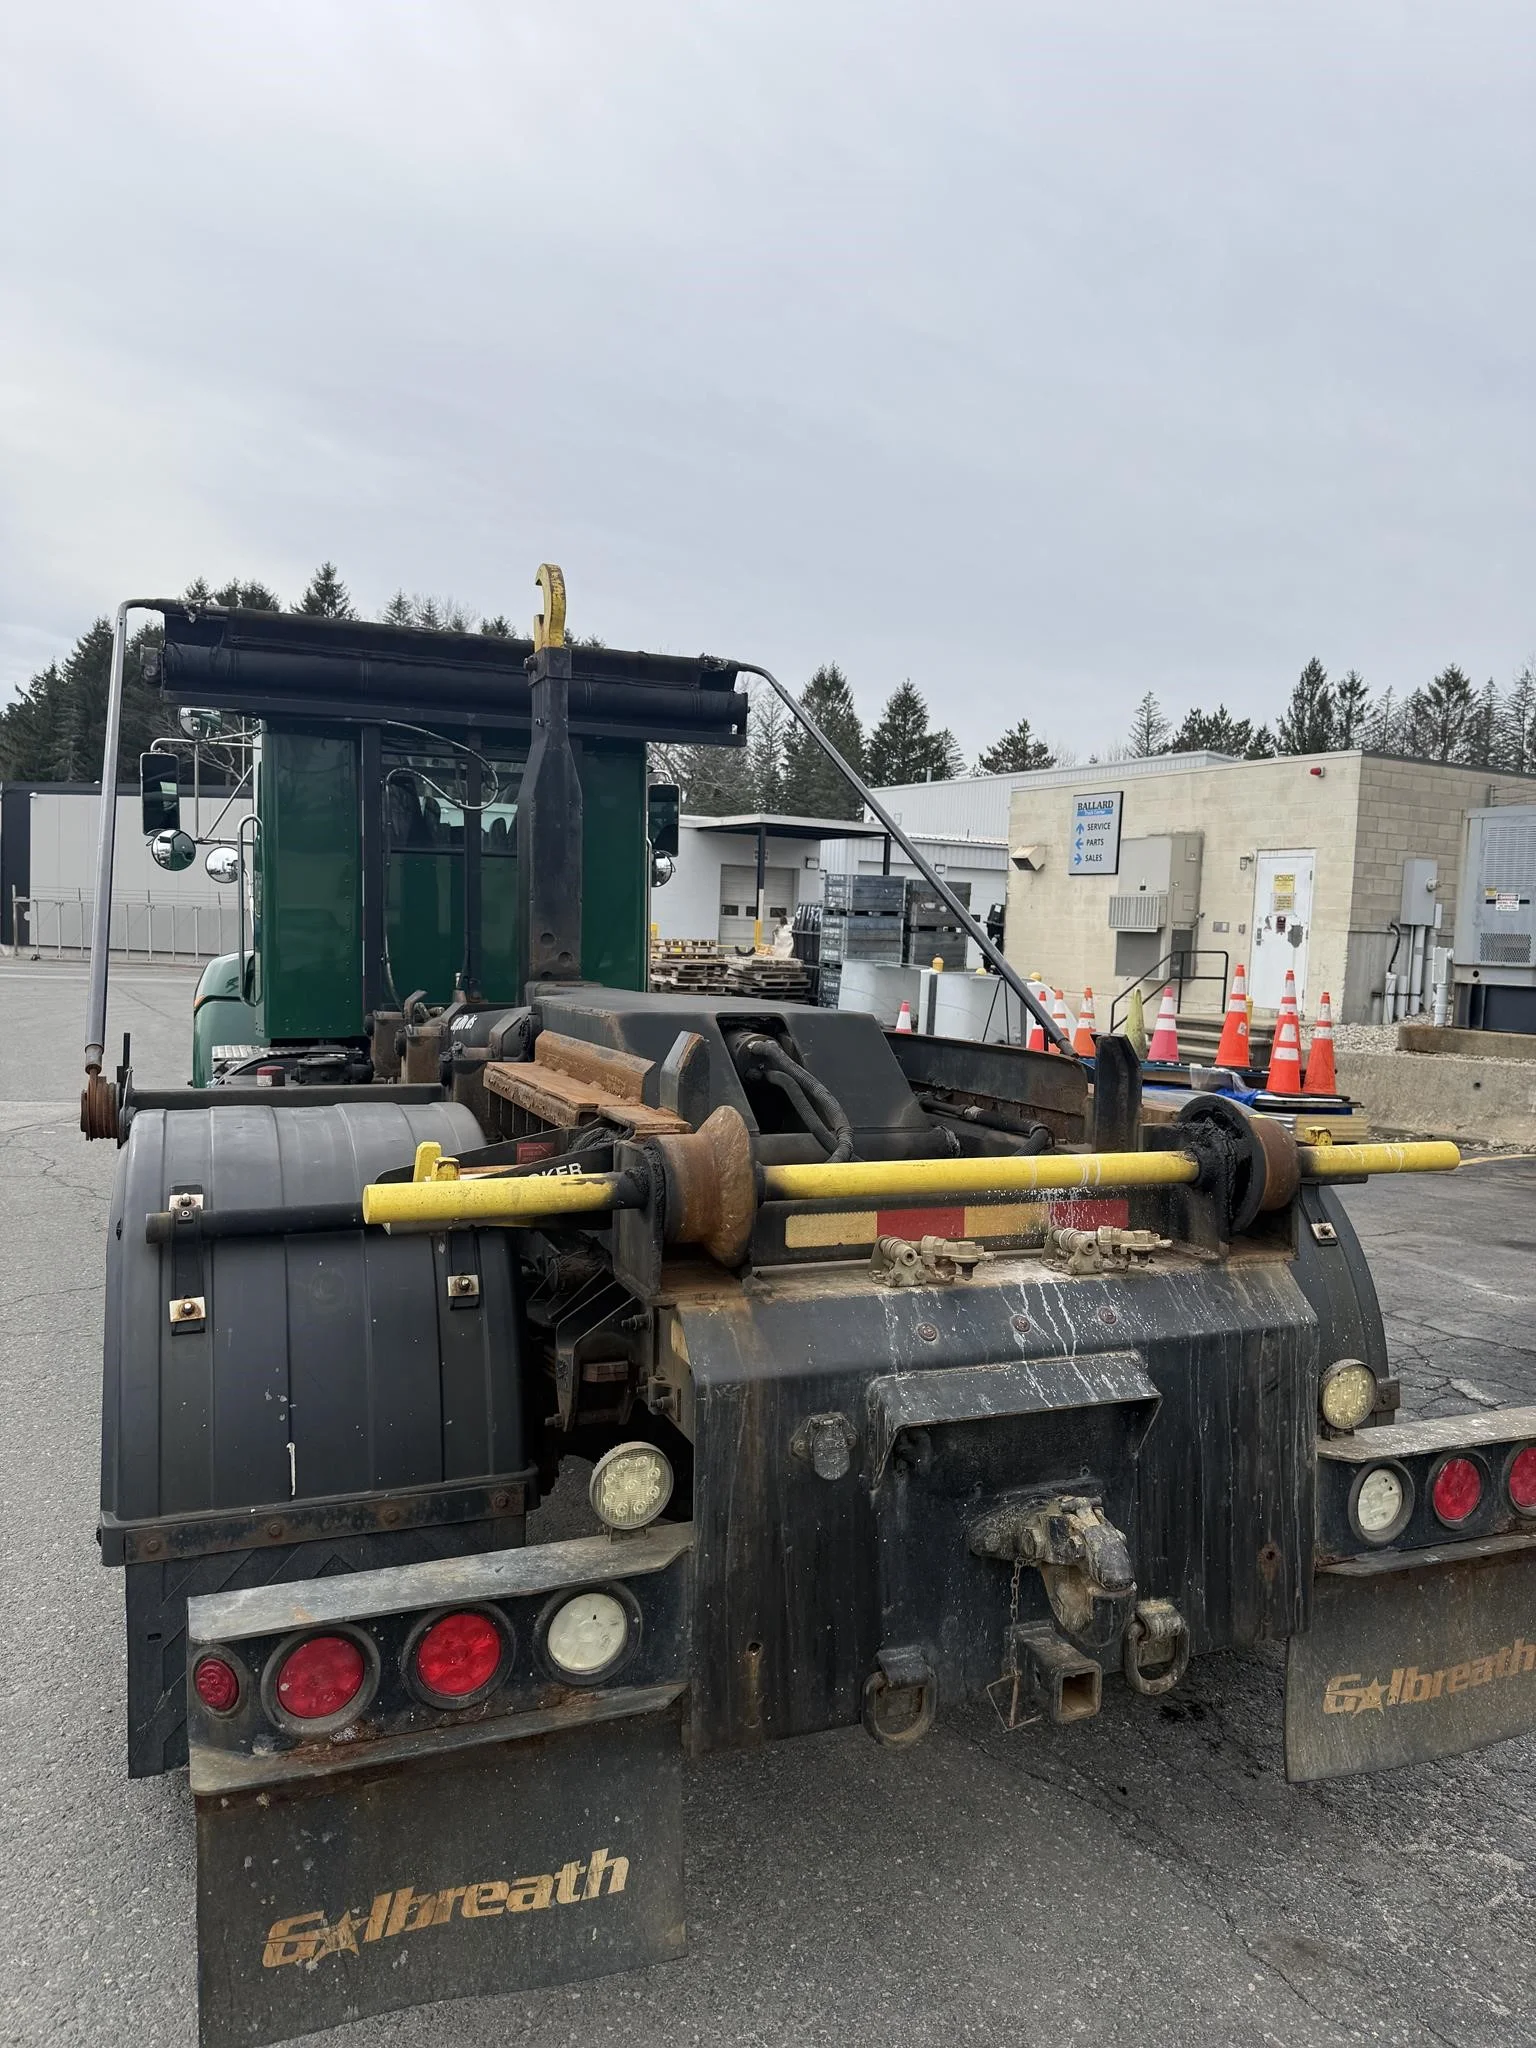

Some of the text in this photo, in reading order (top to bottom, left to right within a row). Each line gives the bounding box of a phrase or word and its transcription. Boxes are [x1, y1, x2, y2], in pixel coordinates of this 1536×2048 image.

[1077, 800, 1114, 810] BALLARD
[1087, 822, 1111, 831] SERVICE
[1086, 838, 1104, 846] PARTS
[1084, 854, 1103, 862] SALES
